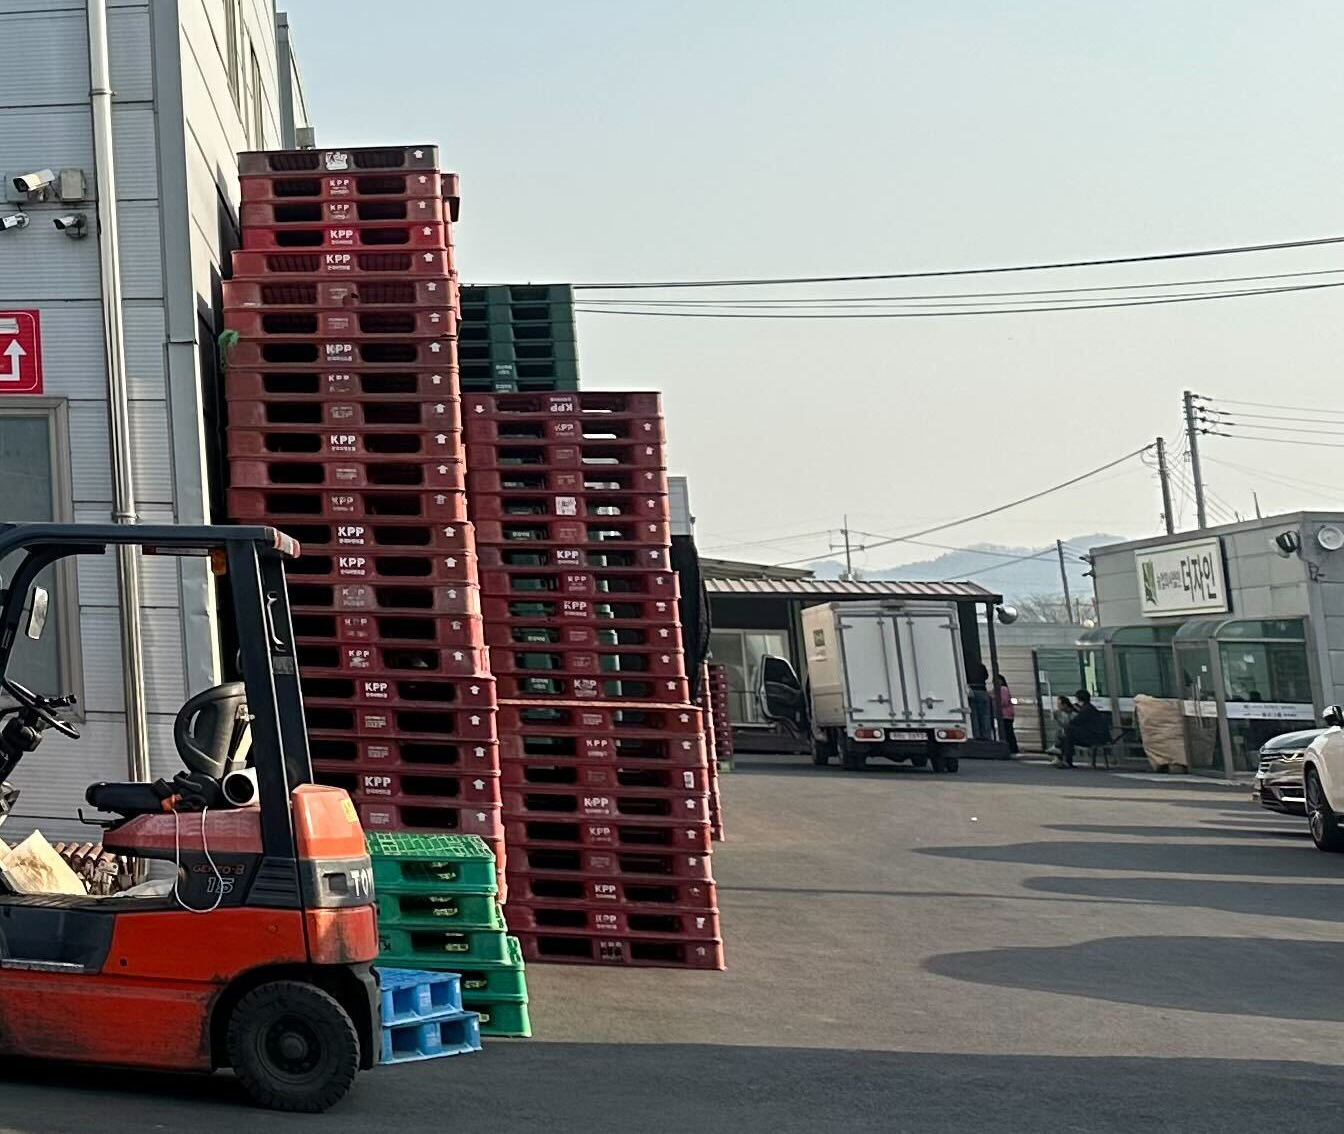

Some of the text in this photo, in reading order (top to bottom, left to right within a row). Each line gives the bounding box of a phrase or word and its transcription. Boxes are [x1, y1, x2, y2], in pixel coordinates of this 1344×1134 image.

[330, 435, 356, 445] KPP
[338, 526, 365, 537] KPP
[557, 550, 579, 559] KPP
[339, 557, 366, 568] KPP
[1180, 552, 1217, 603] 더자인
[564, 600, 587, 610] KPP
[365, 682, 388, 692] KPP
[365, 776, 391, 787] KPP
[584, 797, 609, 807] KPP
[594, 884, 617, 894] KPP
